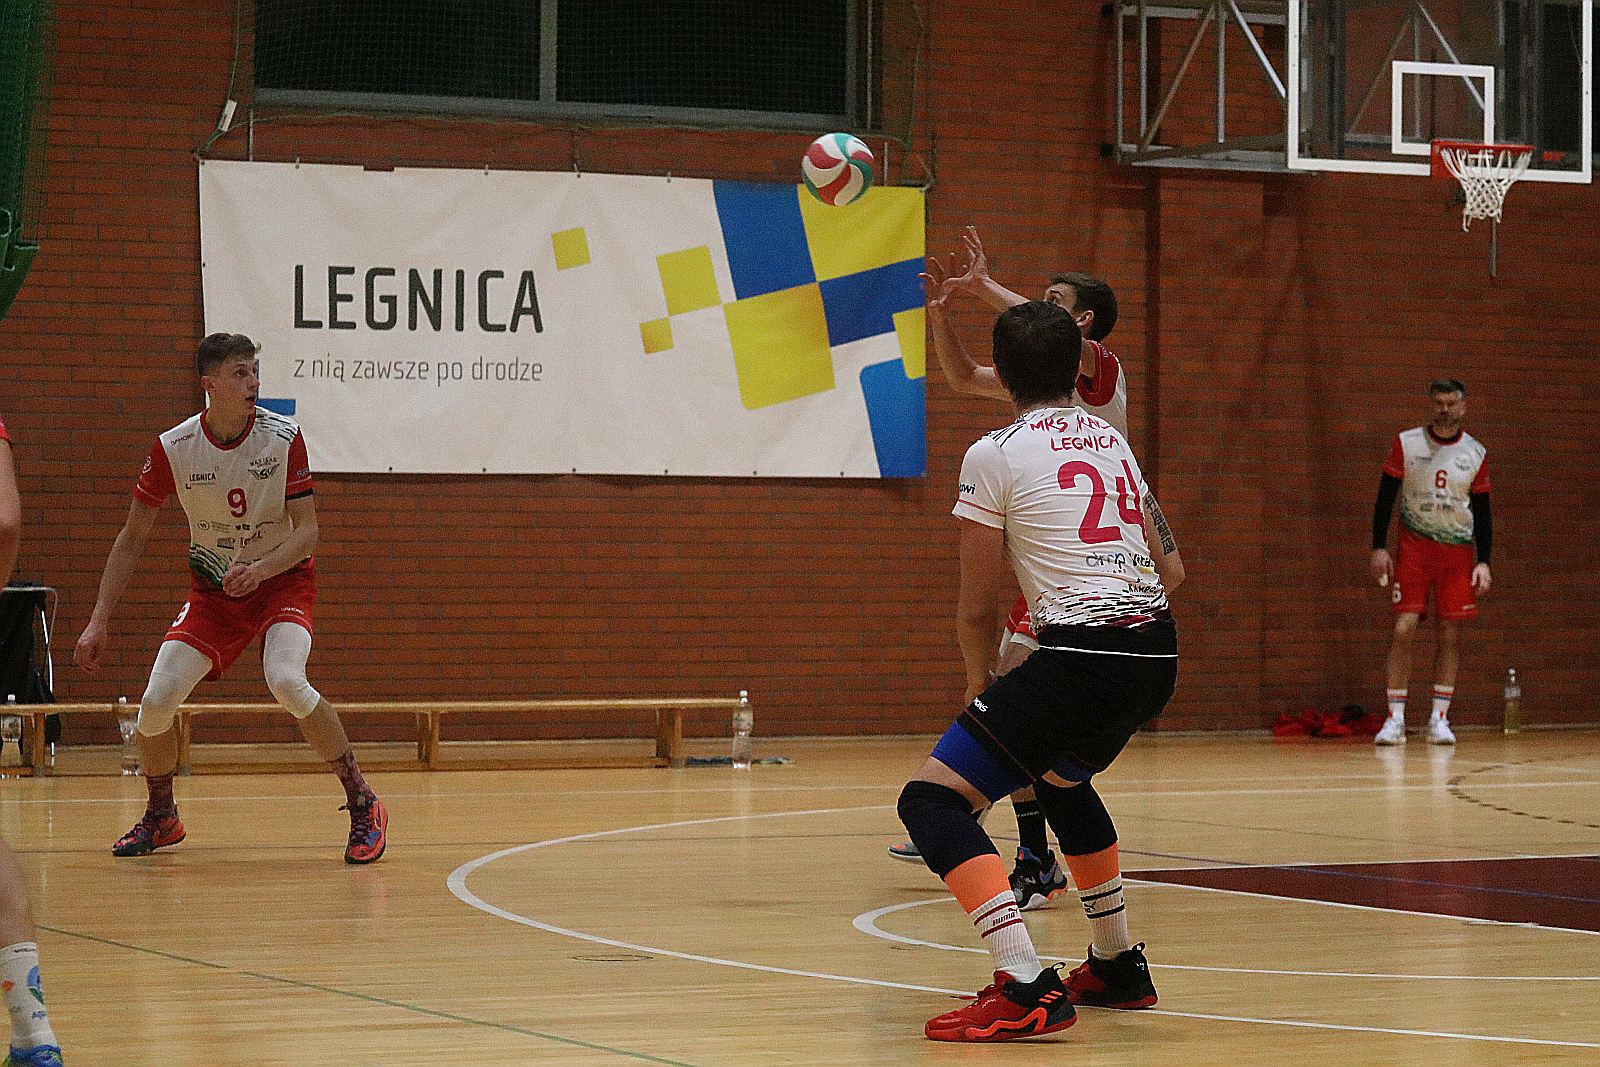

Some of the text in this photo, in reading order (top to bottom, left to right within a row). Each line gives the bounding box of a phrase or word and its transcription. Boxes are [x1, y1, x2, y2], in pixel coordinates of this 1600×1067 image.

[293, 264, 544, 333] LEGNICA
[293, 352, 543, 387] z nią zawsze po drodze
[1030, 417, 1068, 432] MKS
[1051, 434, 1119, 452] LEGNICA
[189, 473, 216, 482] LEGNICA
[1435, 469, 1447, 489] 6
[227, 488, 247, 518] 9
[1057, 459, 1148, 545] 24
[171, 601, 191, 628] 9
